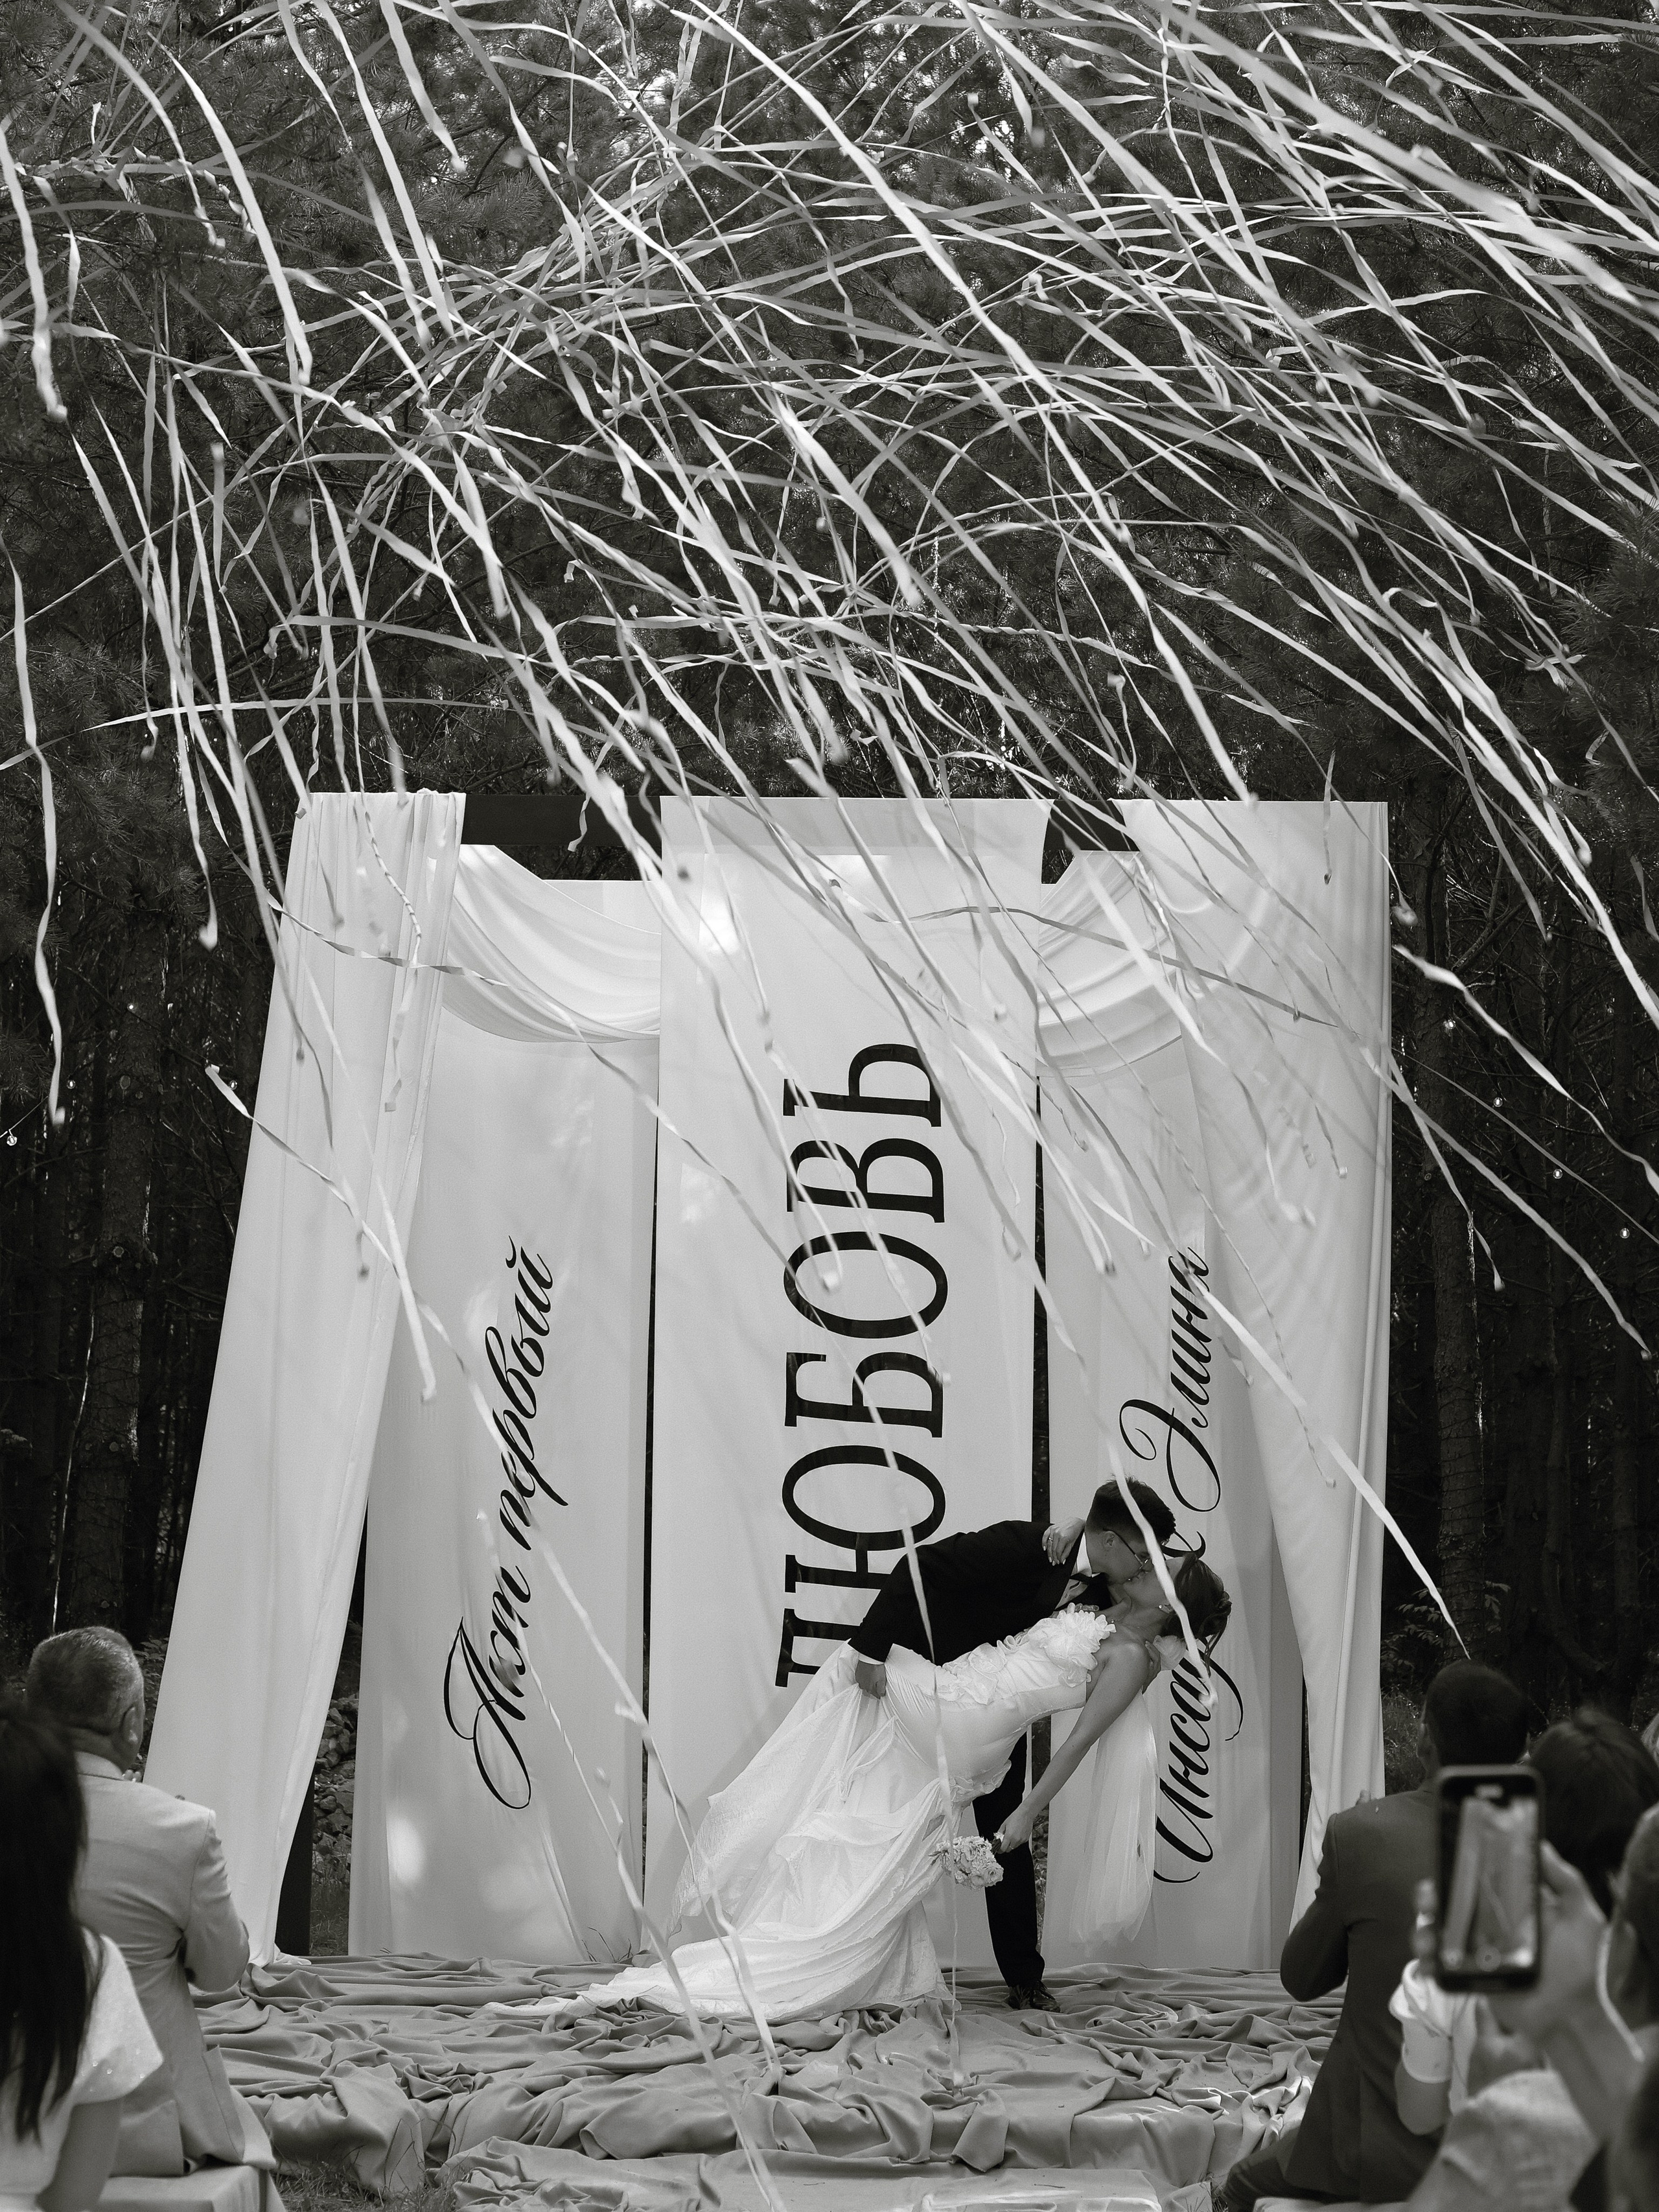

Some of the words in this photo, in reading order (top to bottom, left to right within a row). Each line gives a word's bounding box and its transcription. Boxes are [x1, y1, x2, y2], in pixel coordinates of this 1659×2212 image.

[485, 1235, 569, 1551] первый
[1119, 1246, 1222, 1513] Элина
[443, 1565, 532, 1810] Акт
